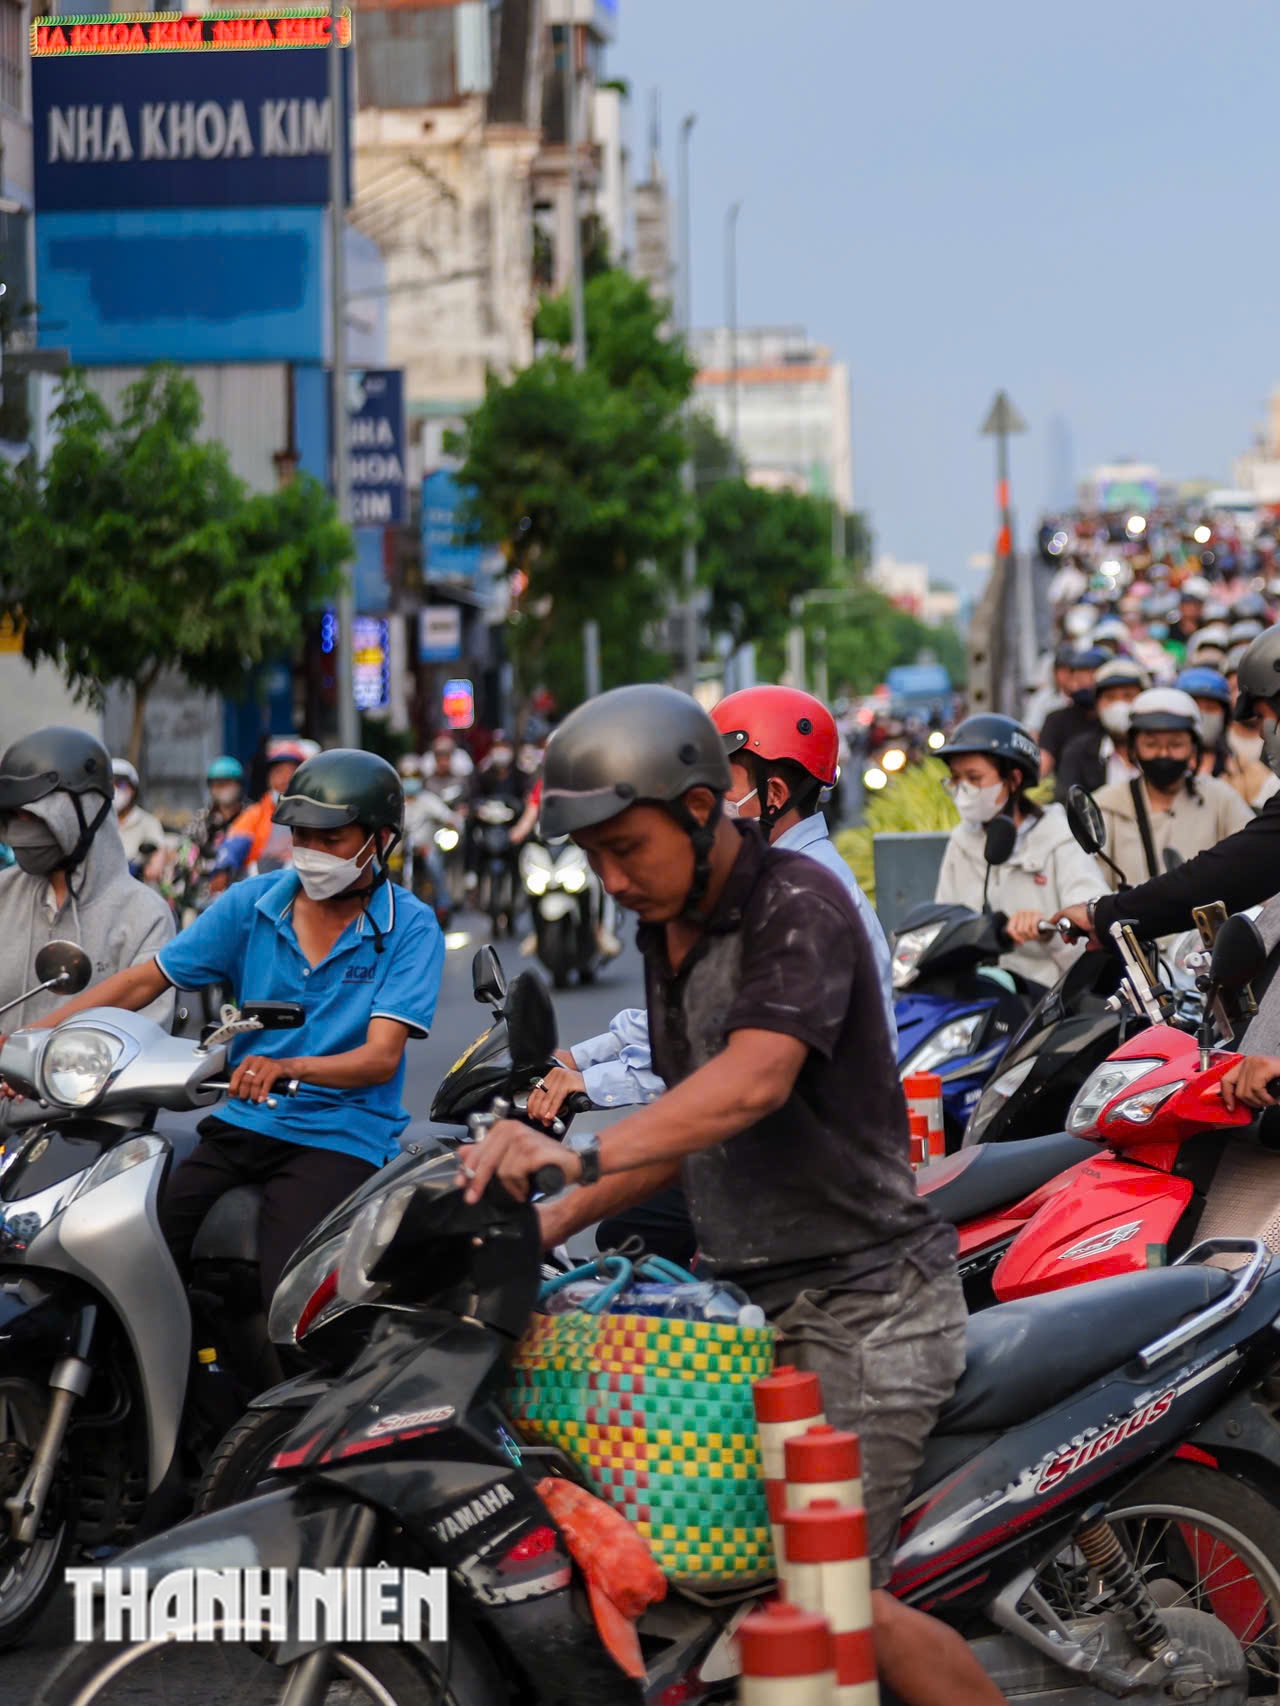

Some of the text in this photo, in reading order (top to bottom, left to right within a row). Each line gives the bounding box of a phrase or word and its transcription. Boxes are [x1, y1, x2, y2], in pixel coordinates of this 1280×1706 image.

[48, 98, 333, 163] NHA KHOA KIM
[432, 1483, 515, 1543] YAMAHA
